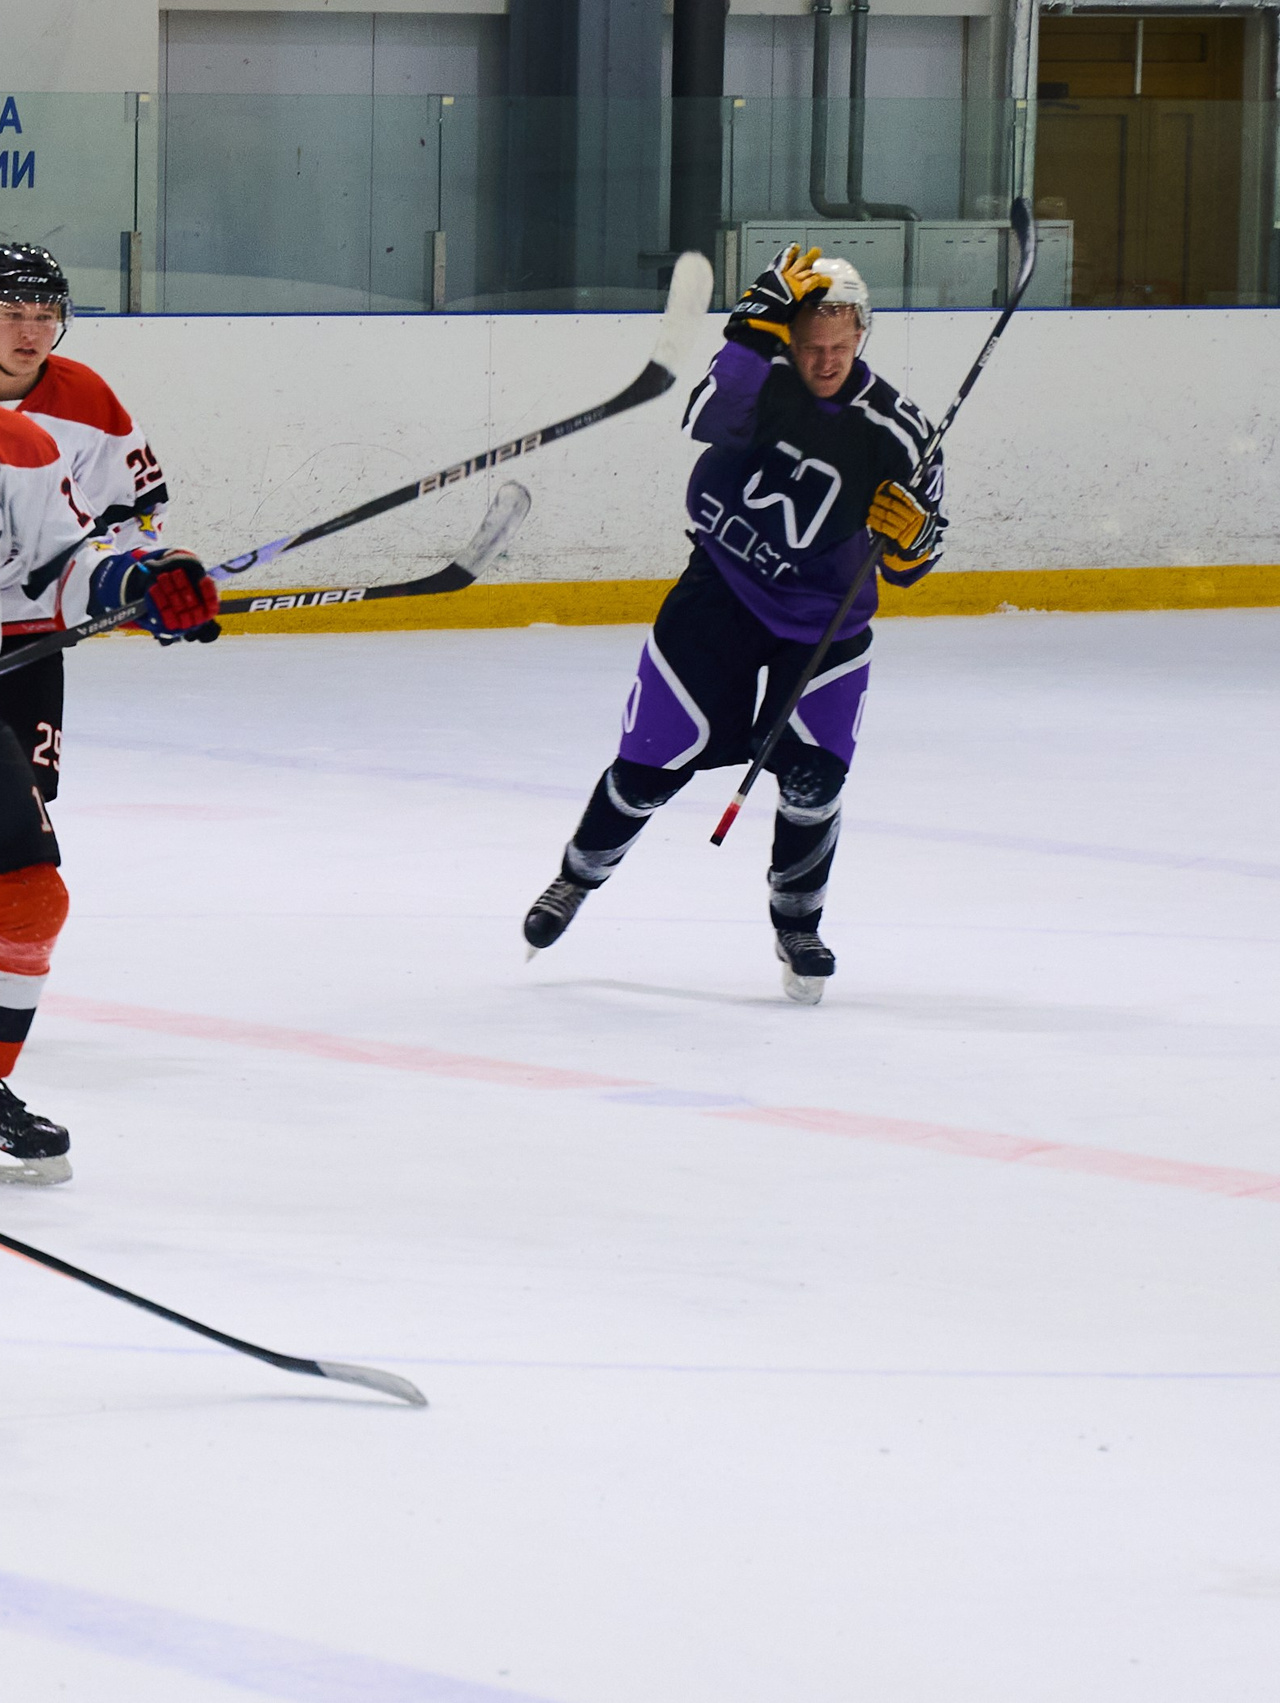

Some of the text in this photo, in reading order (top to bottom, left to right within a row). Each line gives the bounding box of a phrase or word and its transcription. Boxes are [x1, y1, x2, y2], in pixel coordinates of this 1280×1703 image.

[17, 275, 48, 284] CCM
[419, 431, 542, 495] BAUER
[249, 588, 366, 613] BAUER
[32, 721, 62, 773] 29
